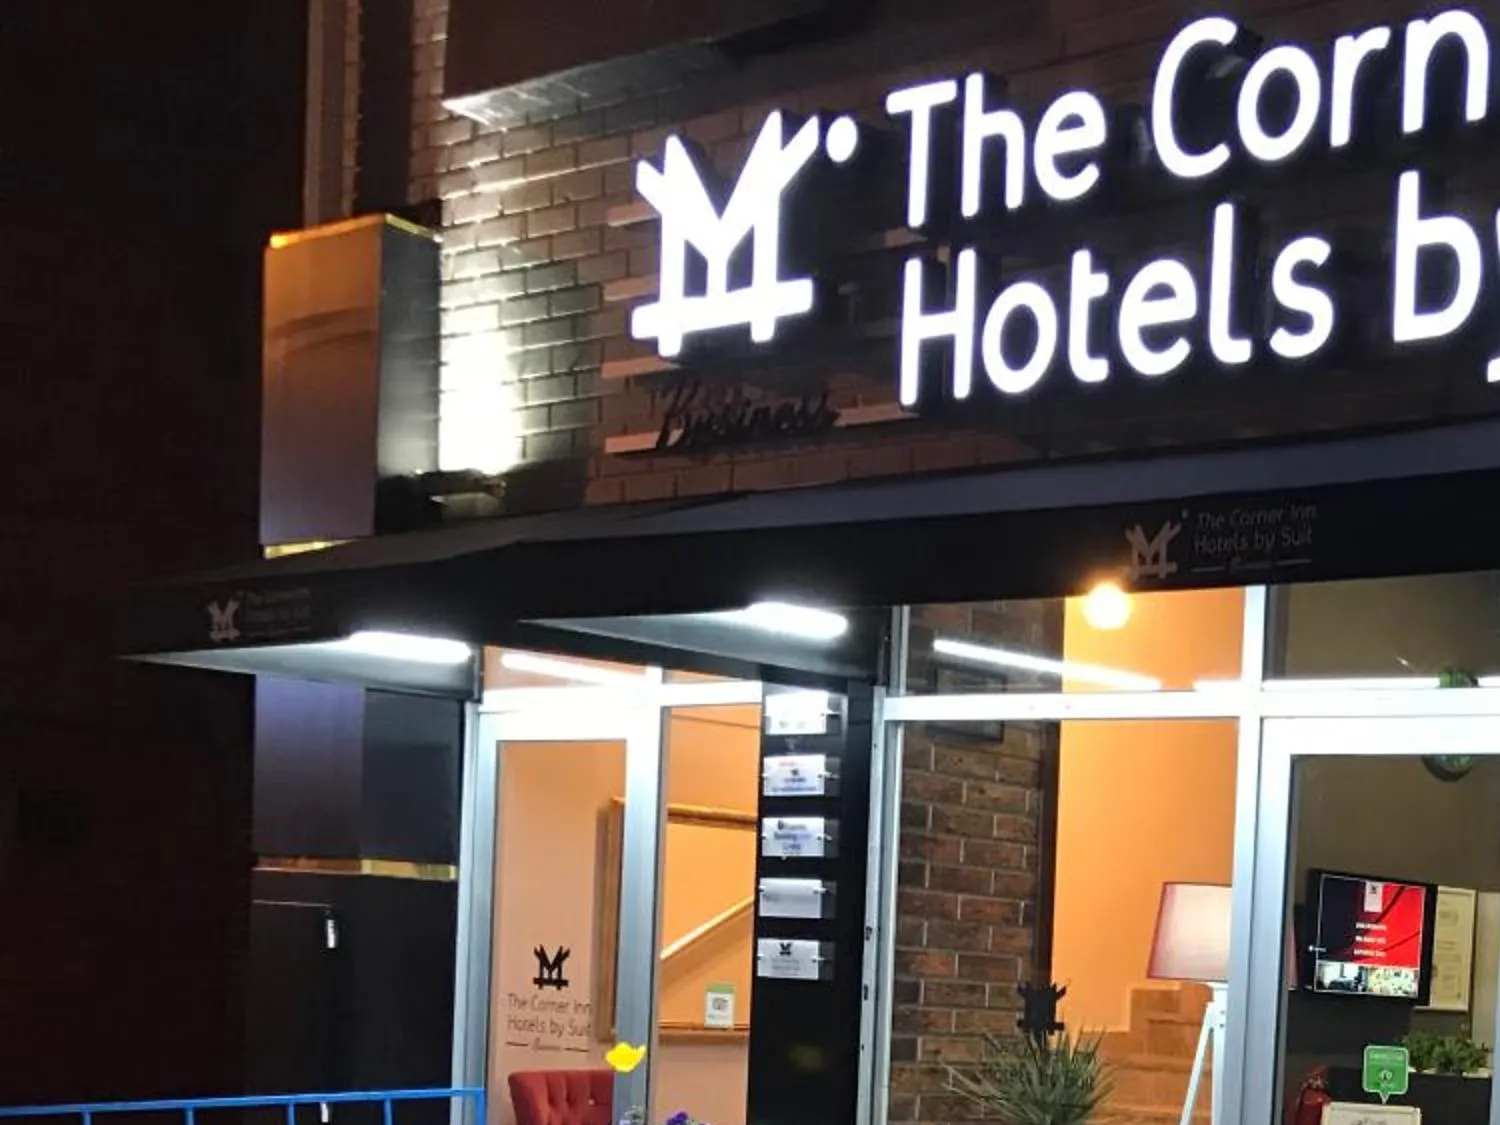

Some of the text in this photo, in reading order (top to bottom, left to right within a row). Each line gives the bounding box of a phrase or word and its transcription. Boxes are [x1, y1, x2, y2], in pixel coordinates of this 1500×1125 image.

[885, 73, 1107, 228] The
[899, 202, 1335, 406] Hotels
[1197, 511, 1225, 529] The
[1229, 507, 1285, 527] Corner
[1193, 522, 1313, 555] Hotels by Suit
[508, 993, 593, 1015] The Corner Inn
[507, 1014, 592, 1039] Hotels by Suit
